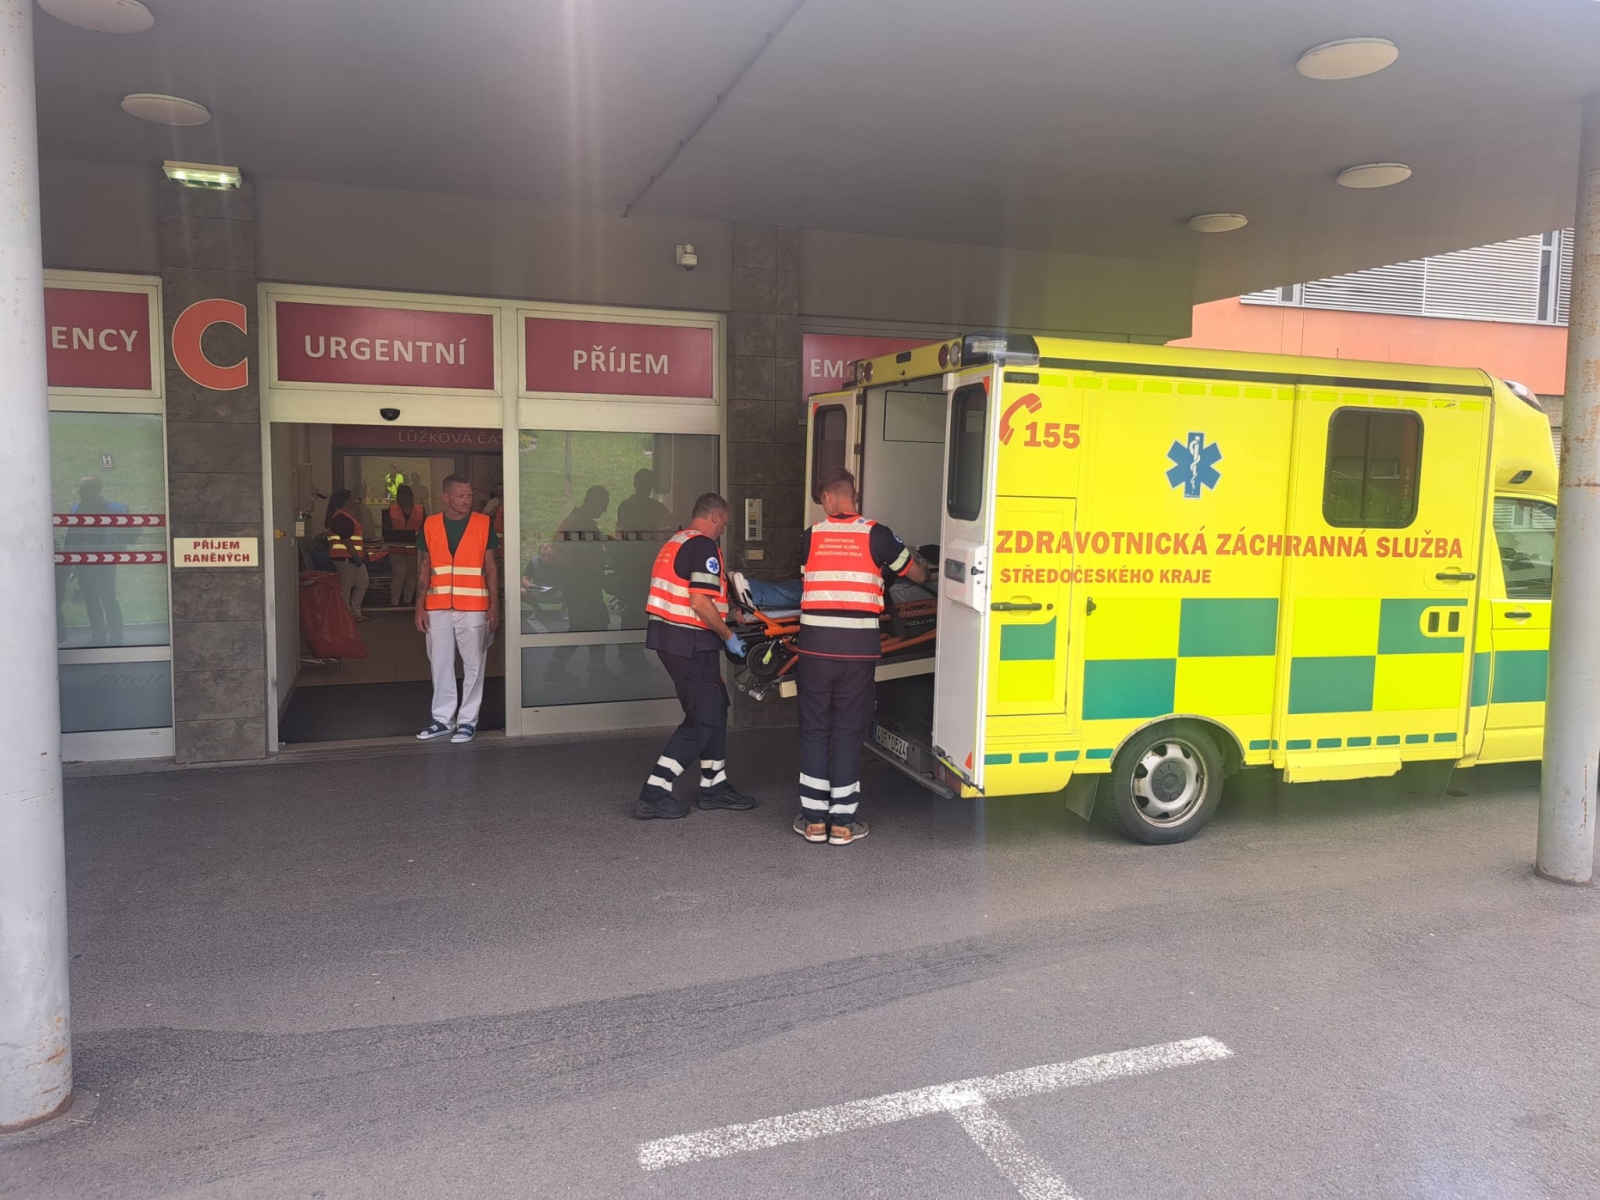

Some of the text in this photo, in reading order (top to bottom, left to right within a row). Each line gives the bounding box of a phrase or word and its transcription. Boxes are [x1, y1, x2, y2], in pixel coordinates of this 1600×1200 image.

[51, 326, 138, 352] ENCY
[172, 298, 249, 390] C
[304, 335, 468, 365] URGENTNÍ
[572, 345, 670, 375] PŘÍJEM
[810, 358, 855, 378] EM
[398, 428, 472, 443] LŮŽKOVÁ
[1023, 421, 1081, 449] 155
[193, 539, 240, 550] PŘÍJEM
[995, 525, 1463, 558] ZDRAVOTNICKÁ ZÁCHRANNÁ SLUŽBA
[183, 552, 250, 563] RANĚNÝCH
[1000, 564, 1212, 583] STŘEDOČESKÉHO KRAJE
